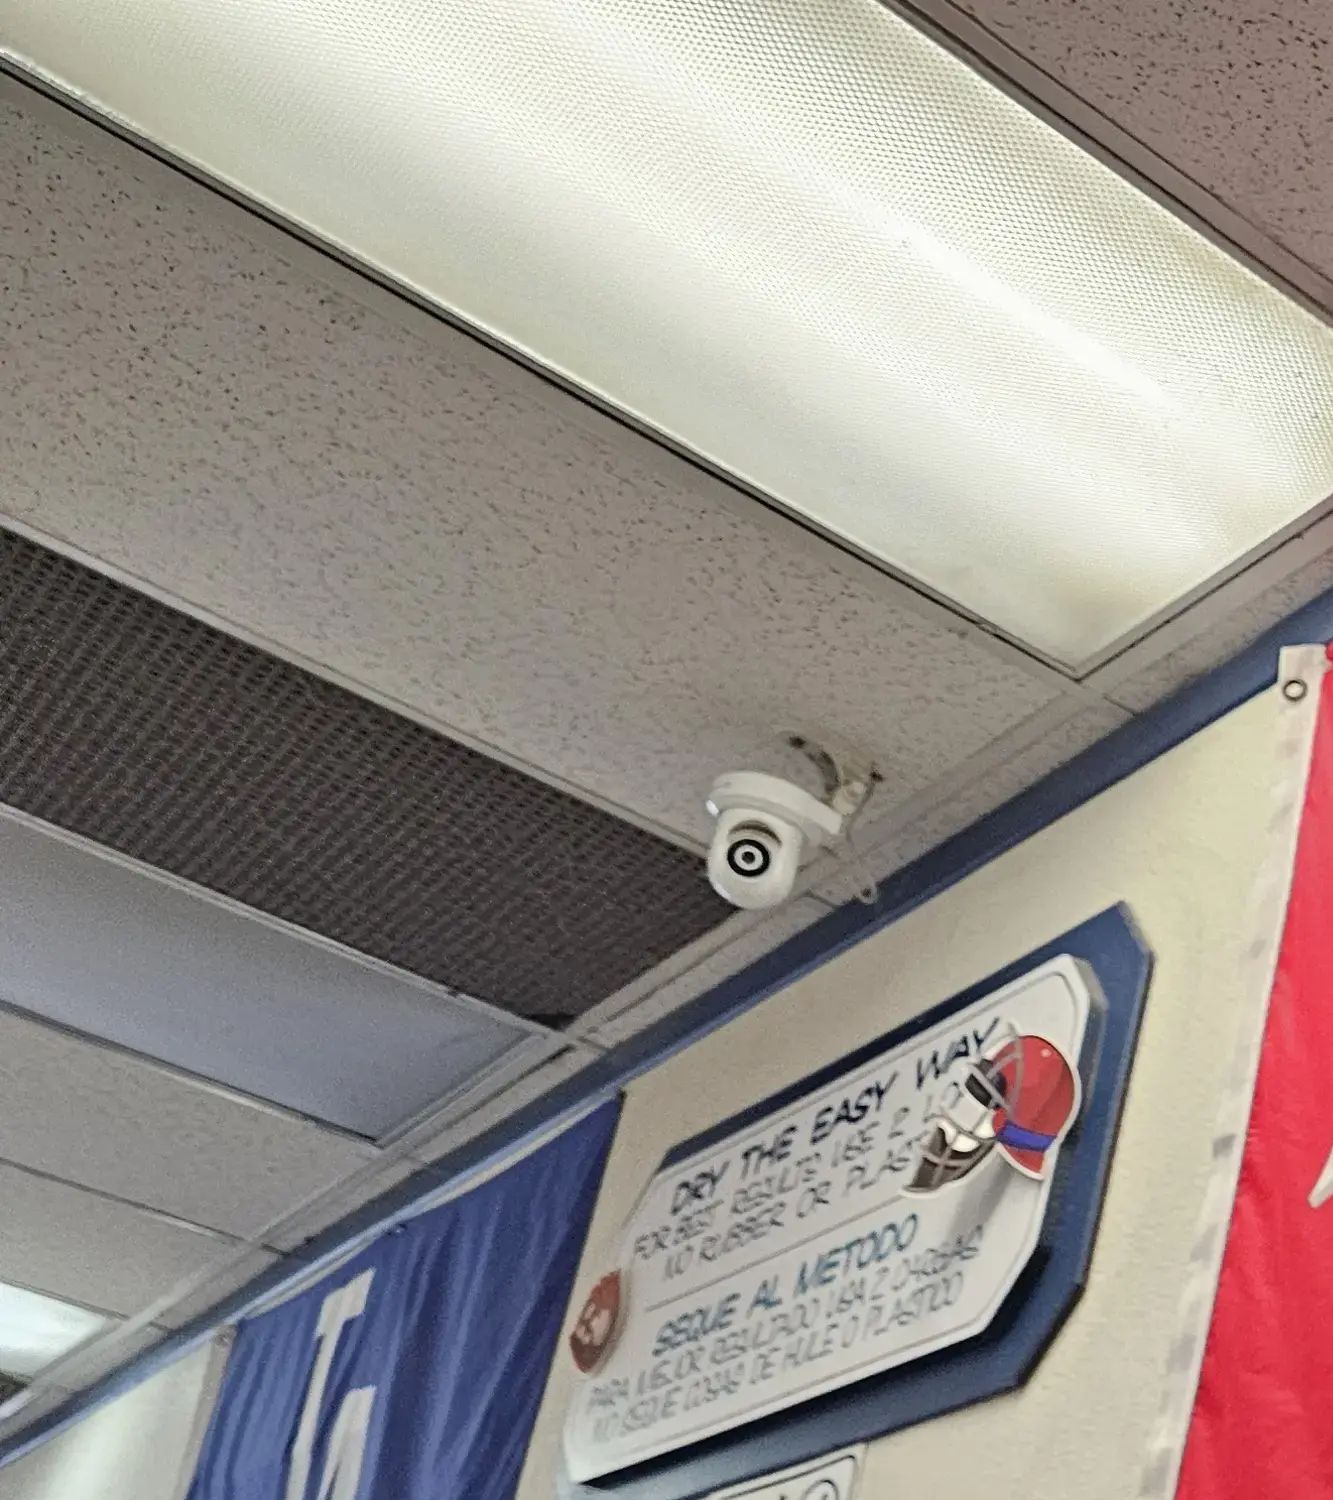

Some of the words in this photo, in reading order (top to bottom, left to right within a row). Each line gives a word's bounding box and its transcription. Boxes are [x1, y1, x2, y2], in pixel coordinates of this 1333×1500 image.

[671, 1161, 730, 1216] DRY
[741, 1125, 798, 1181] THE
[809, 1071, 898, 1146] EASY
[916, 1017, 1000, 1092] WAY
[747, 1274, 784, 1320] AL
[796, 1212, 918, 1296] METODO
